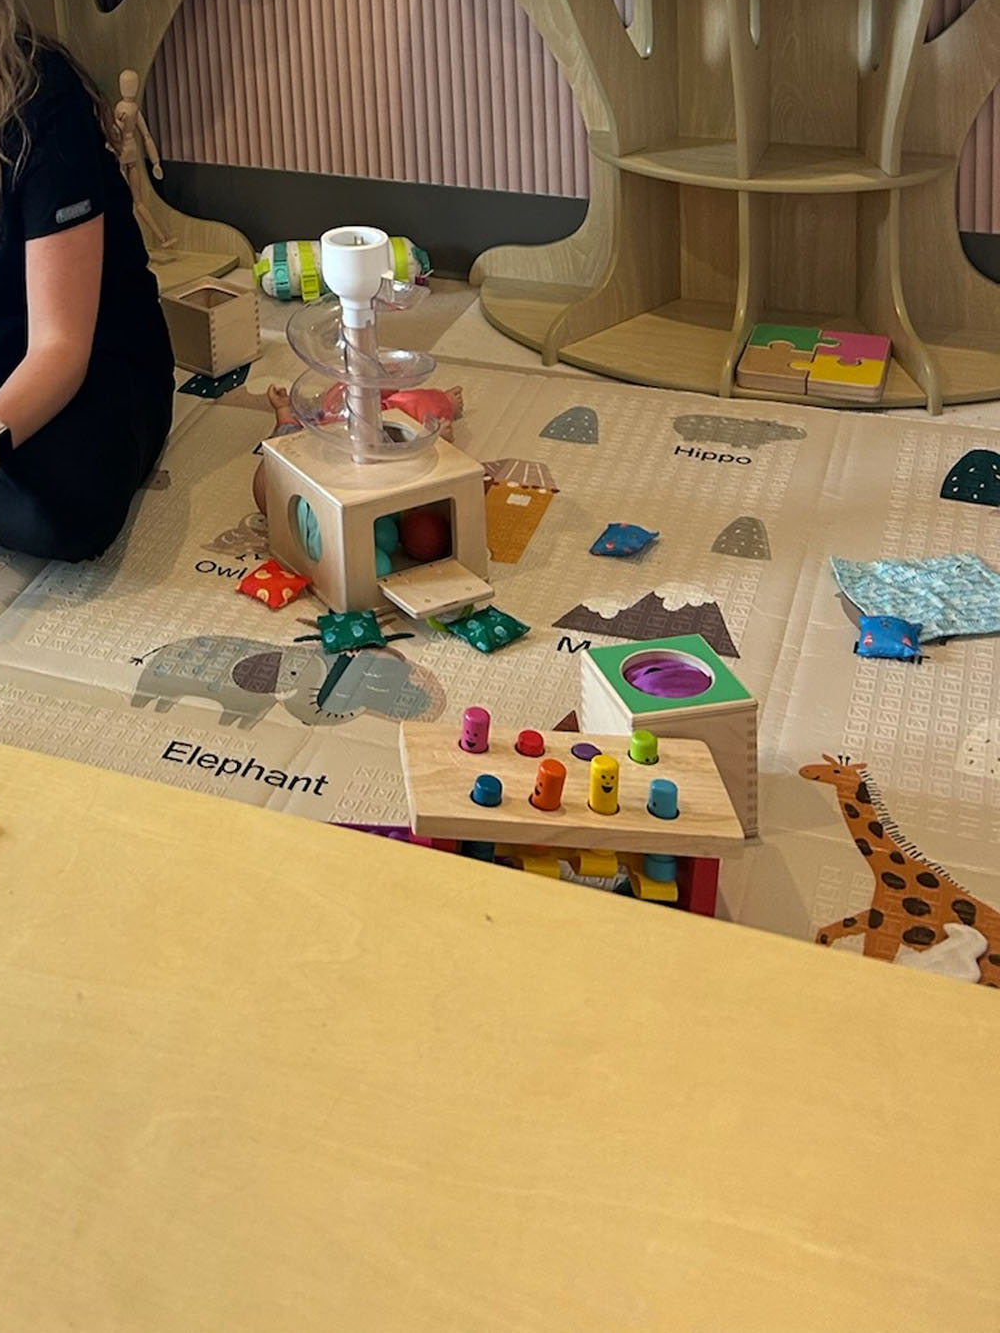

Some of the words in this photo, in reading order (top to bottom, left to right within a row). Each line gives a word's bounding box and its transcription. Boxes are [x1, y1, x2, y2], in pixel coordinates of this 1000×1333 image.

[674, 445, 752, 465] Hippo
[195, 560, 248, 580] Owl
[161, 740, 329, 797] Elephant
